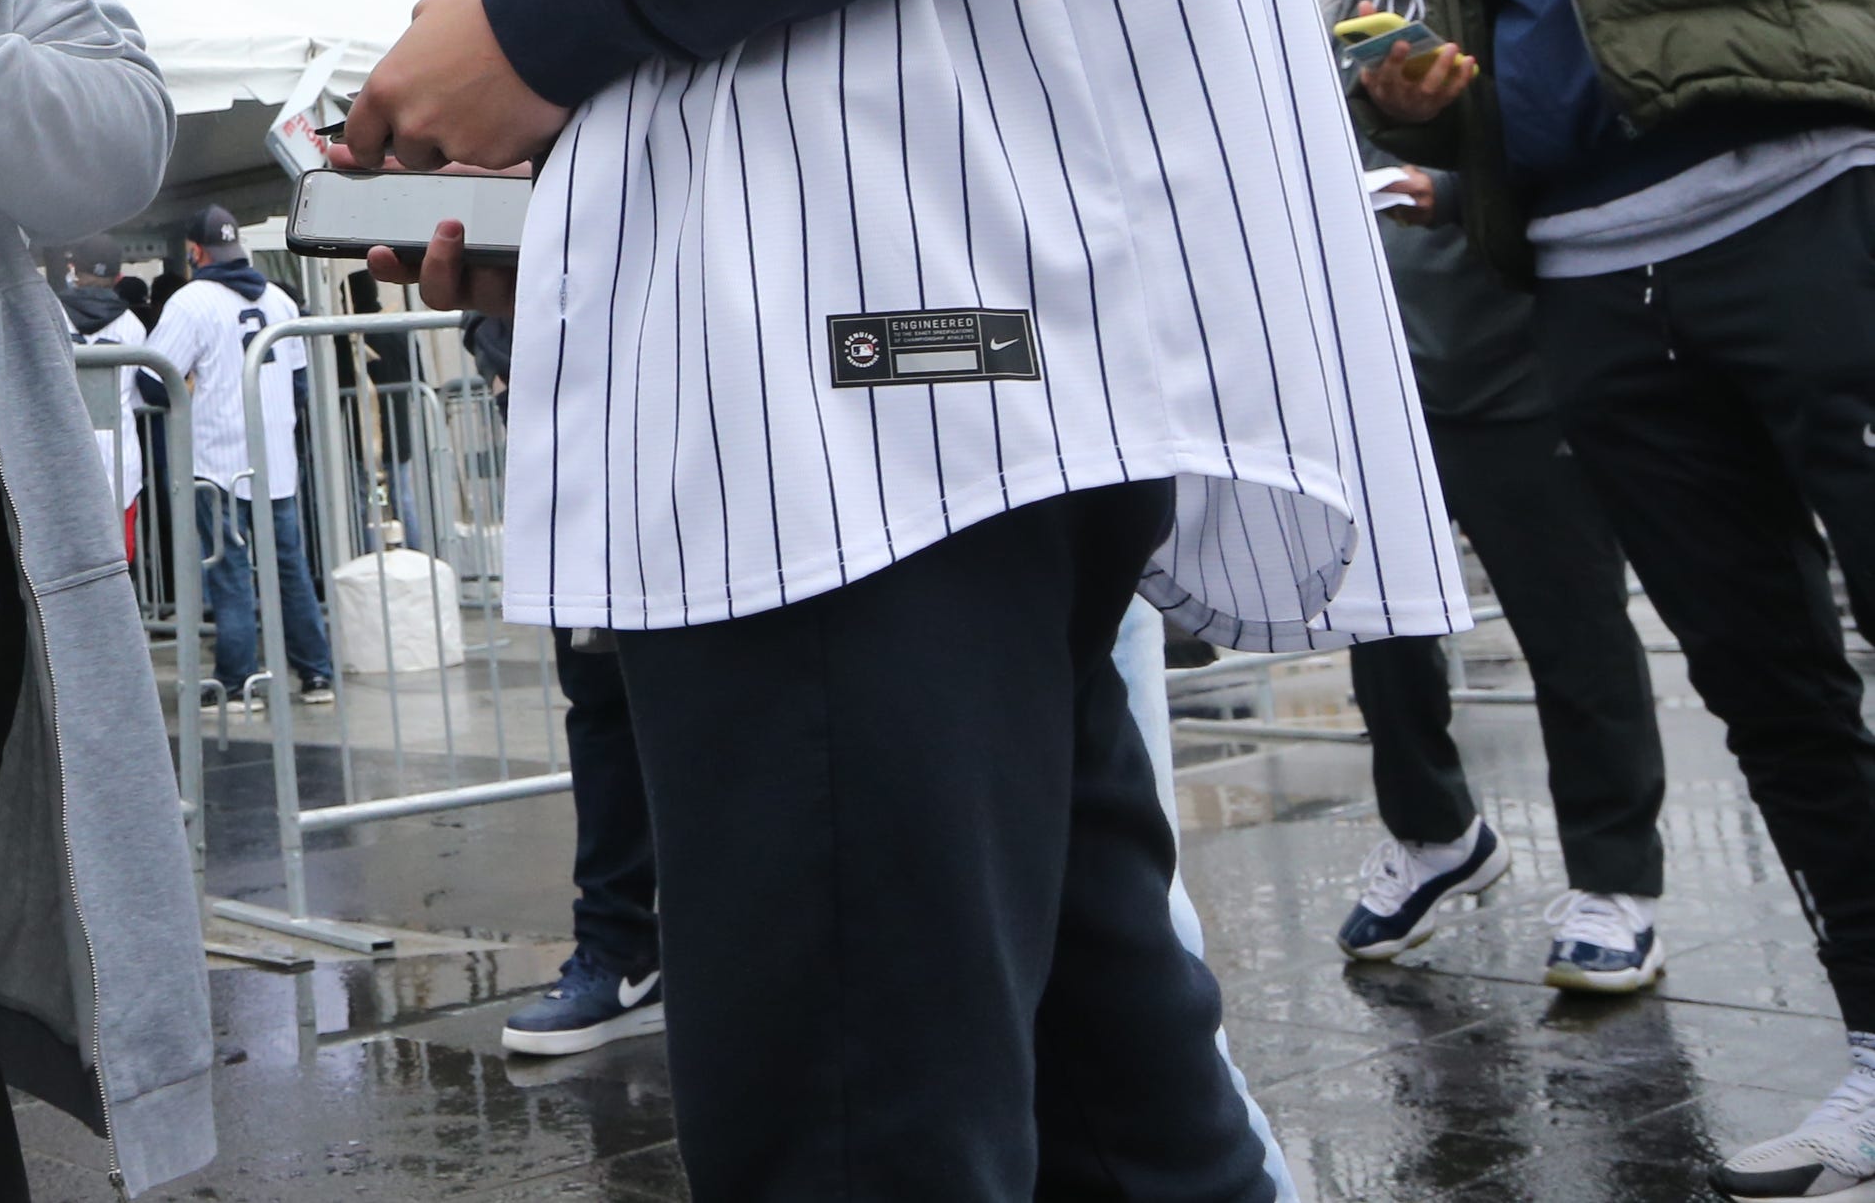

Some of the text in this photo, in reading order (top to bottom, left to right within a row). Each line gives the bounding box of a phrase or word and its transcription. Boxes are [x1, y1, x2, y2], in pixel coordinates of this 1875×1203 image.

[892, 318, 974, 331] ENGINEERED
[239, 308, 276, 363] 2
[844, 332, 879, 346] GENUINE
